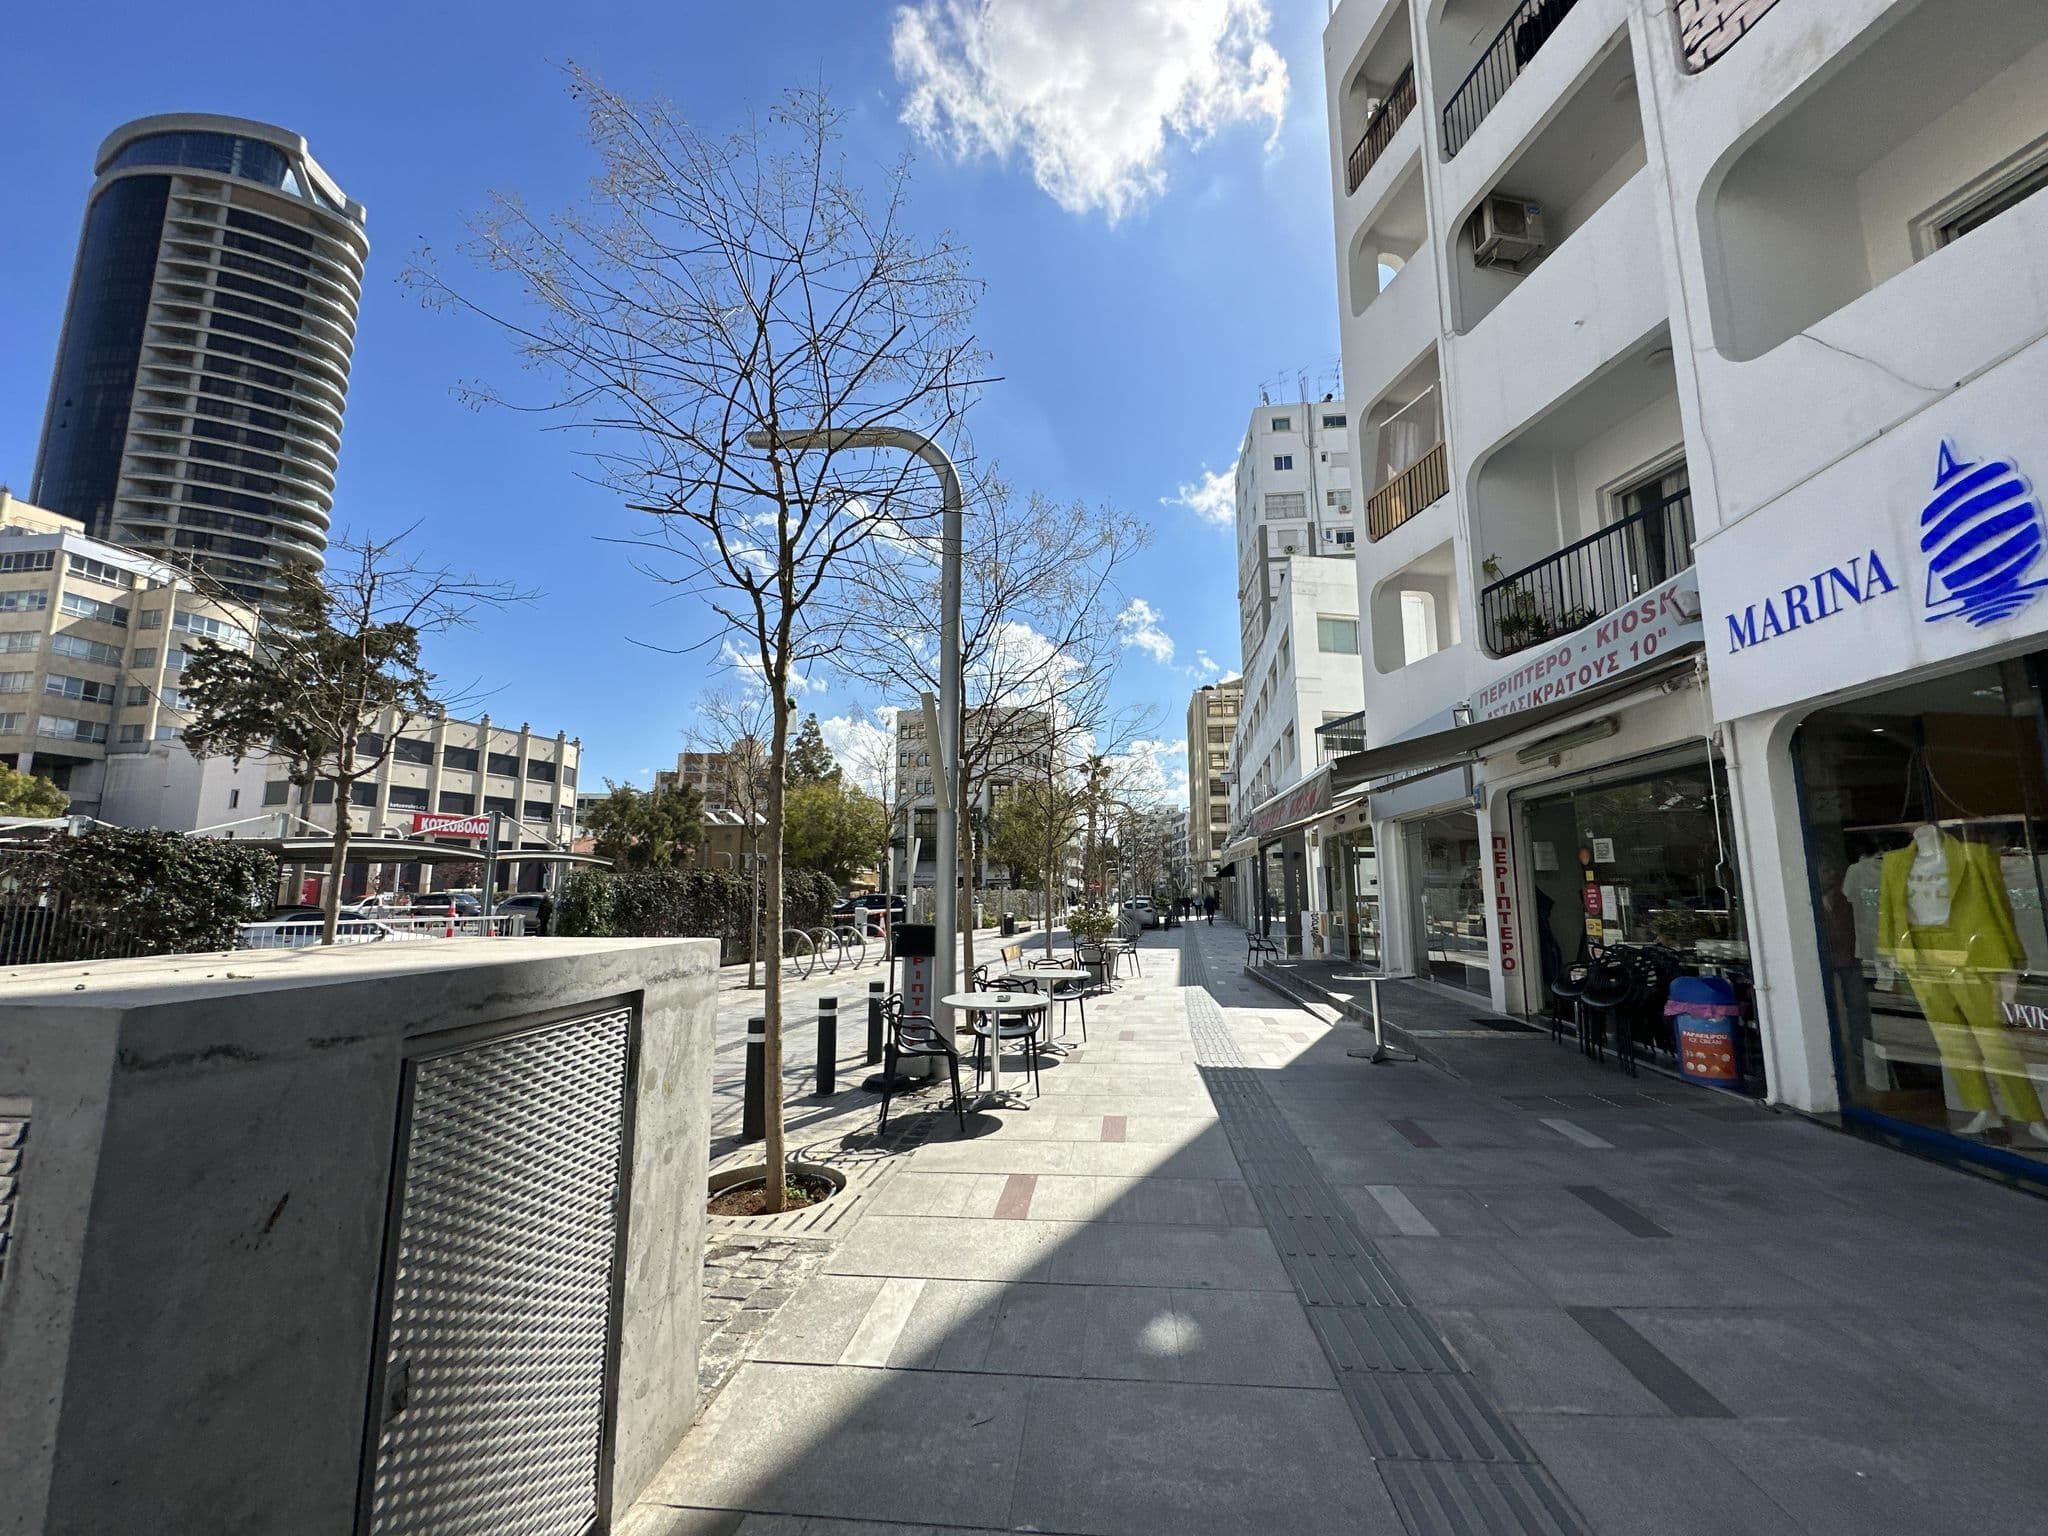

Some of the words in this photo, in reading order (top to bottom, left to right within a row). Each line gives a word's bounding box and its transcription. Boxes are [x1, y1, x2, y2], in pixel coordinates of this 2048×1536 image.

[1725, 549, 1899, 654] MARINA
[1479, 646, 1573, 709] ΠΕΡΙΠΤΕΡΟ
[1629, 626, 1667, 662] 10"
[1492, 836, 1516, 971] ΠΕΡΙΠΤΕΡΟ
